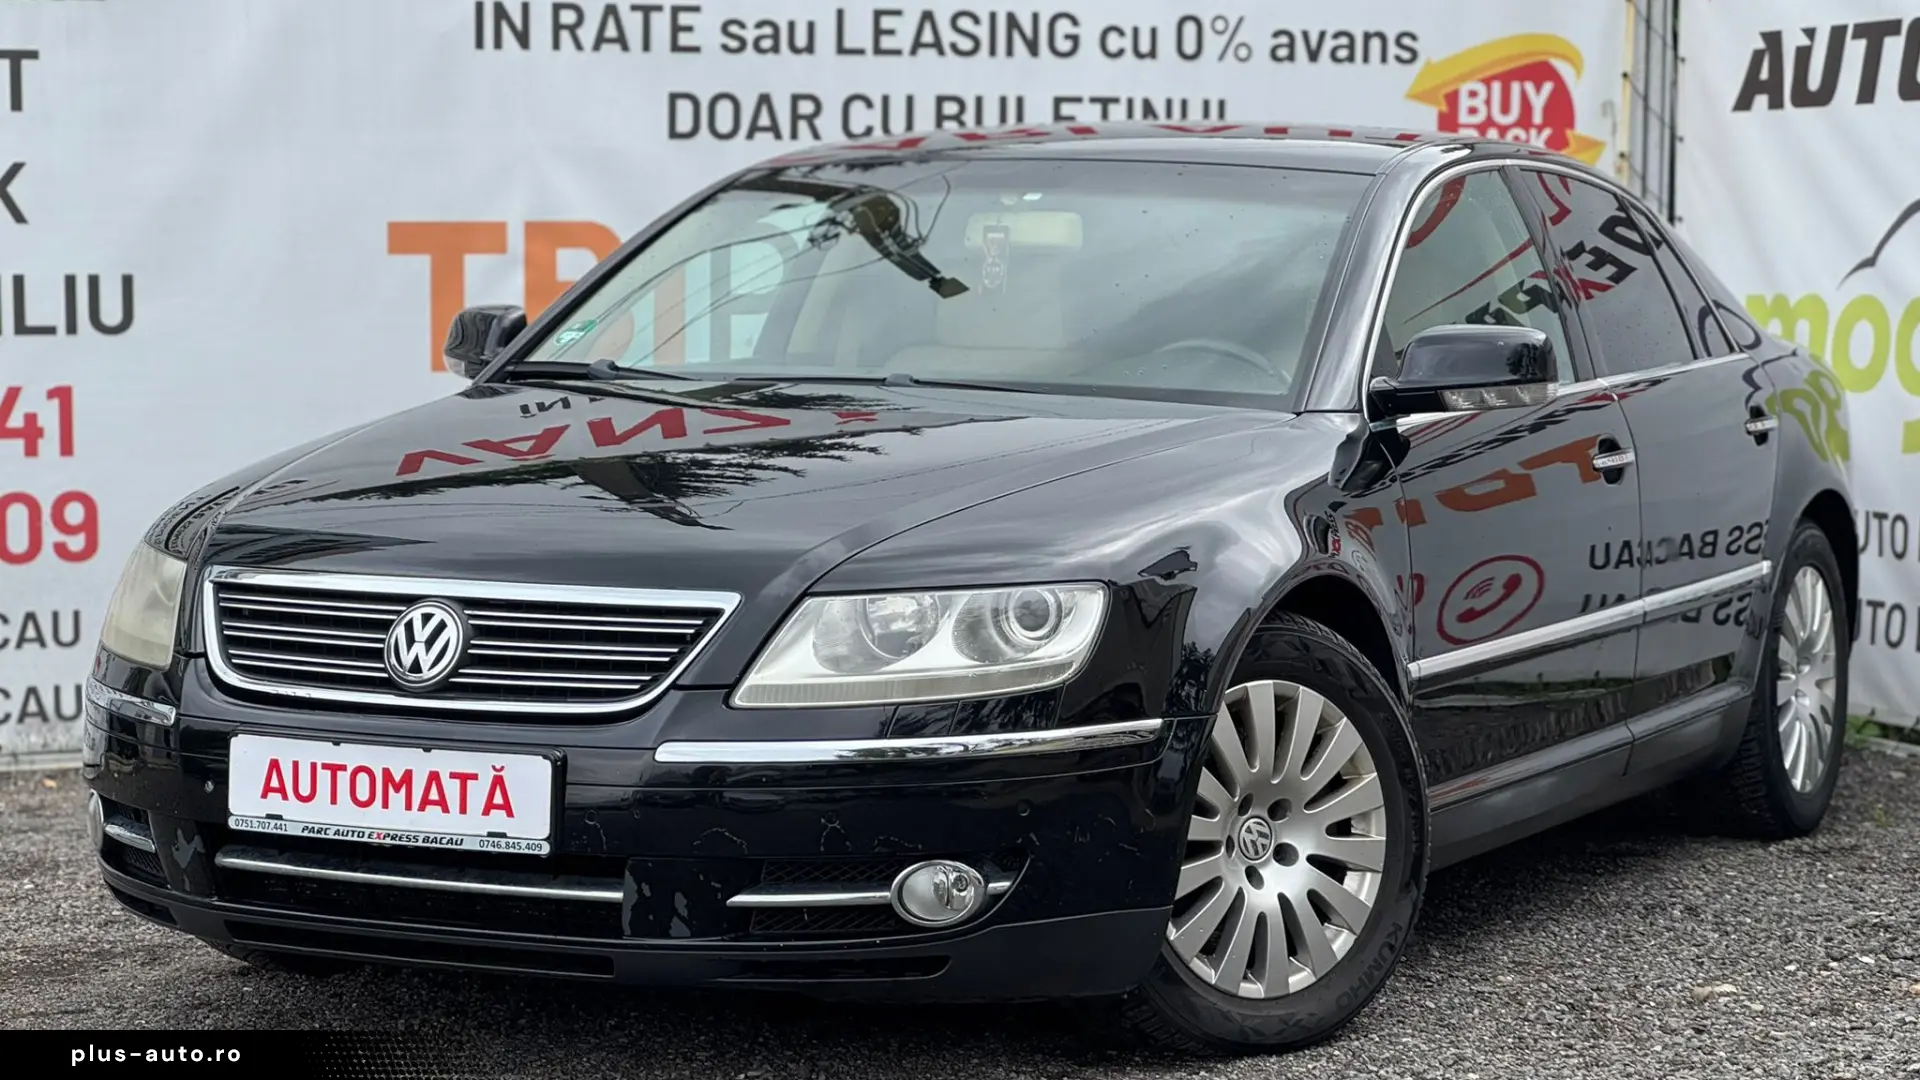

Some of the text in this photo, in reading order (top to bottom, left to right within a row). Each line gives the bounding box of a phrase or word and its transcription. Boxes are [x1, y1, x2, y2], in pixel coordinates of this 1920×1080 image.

[475, 0, 1420, 65] IN RATE sau LEASING cu 0% avans
[0, 50, 39, 112] T
[1458, 80, 1554, 126] BUY
[667, 92, 823, 141] DOAR
[841, 94, 913, 139] CU
[0, 274, 134, 335] LIU
[0, 385, 74, 457] 41
[0, 490, 99, 566] 09
[260, 758, 515, 819] AUTOMATĂ
[234, 818, 543, 852] 0751.707.441 PARC AUTO EXPRESS BACAU 0746.845.409
